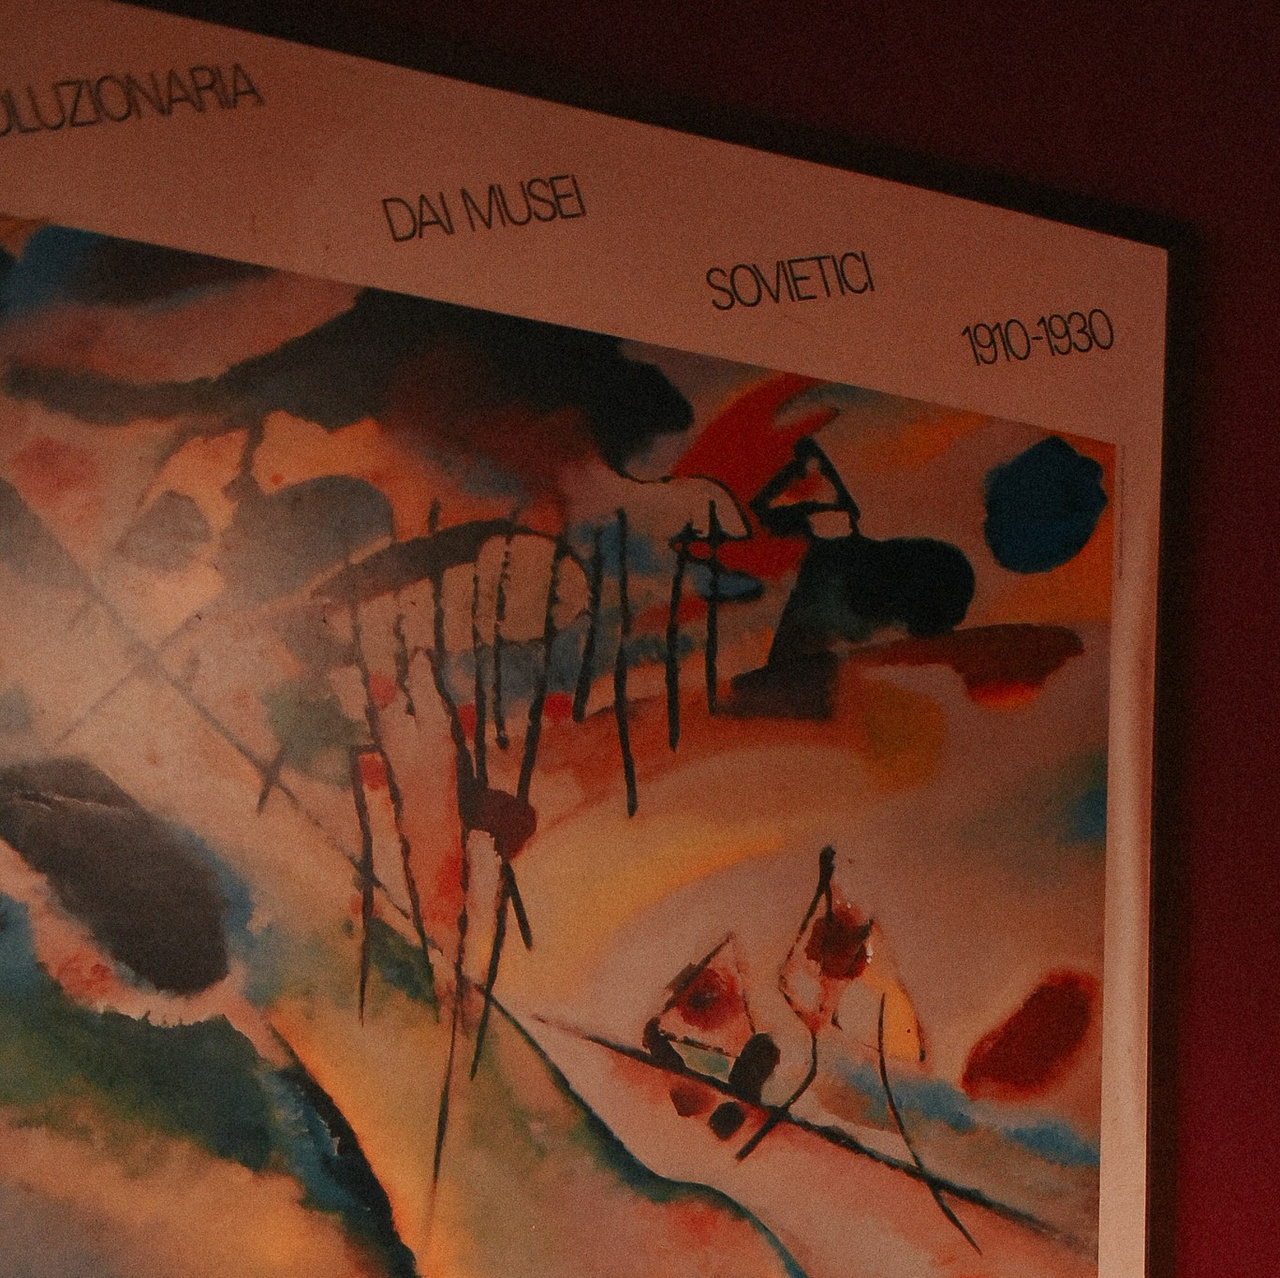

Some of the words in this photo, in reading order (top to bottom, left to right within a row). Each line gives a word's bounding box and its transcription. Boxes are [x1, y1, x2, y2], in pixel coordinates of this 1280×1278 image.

[381, 191, 455, 243] DAI
[460, 173, 587, 233] MUSEI
[705, 250, 876, 311] SOVIETICI
[961, 307, 1115, 367] 1910-1930
